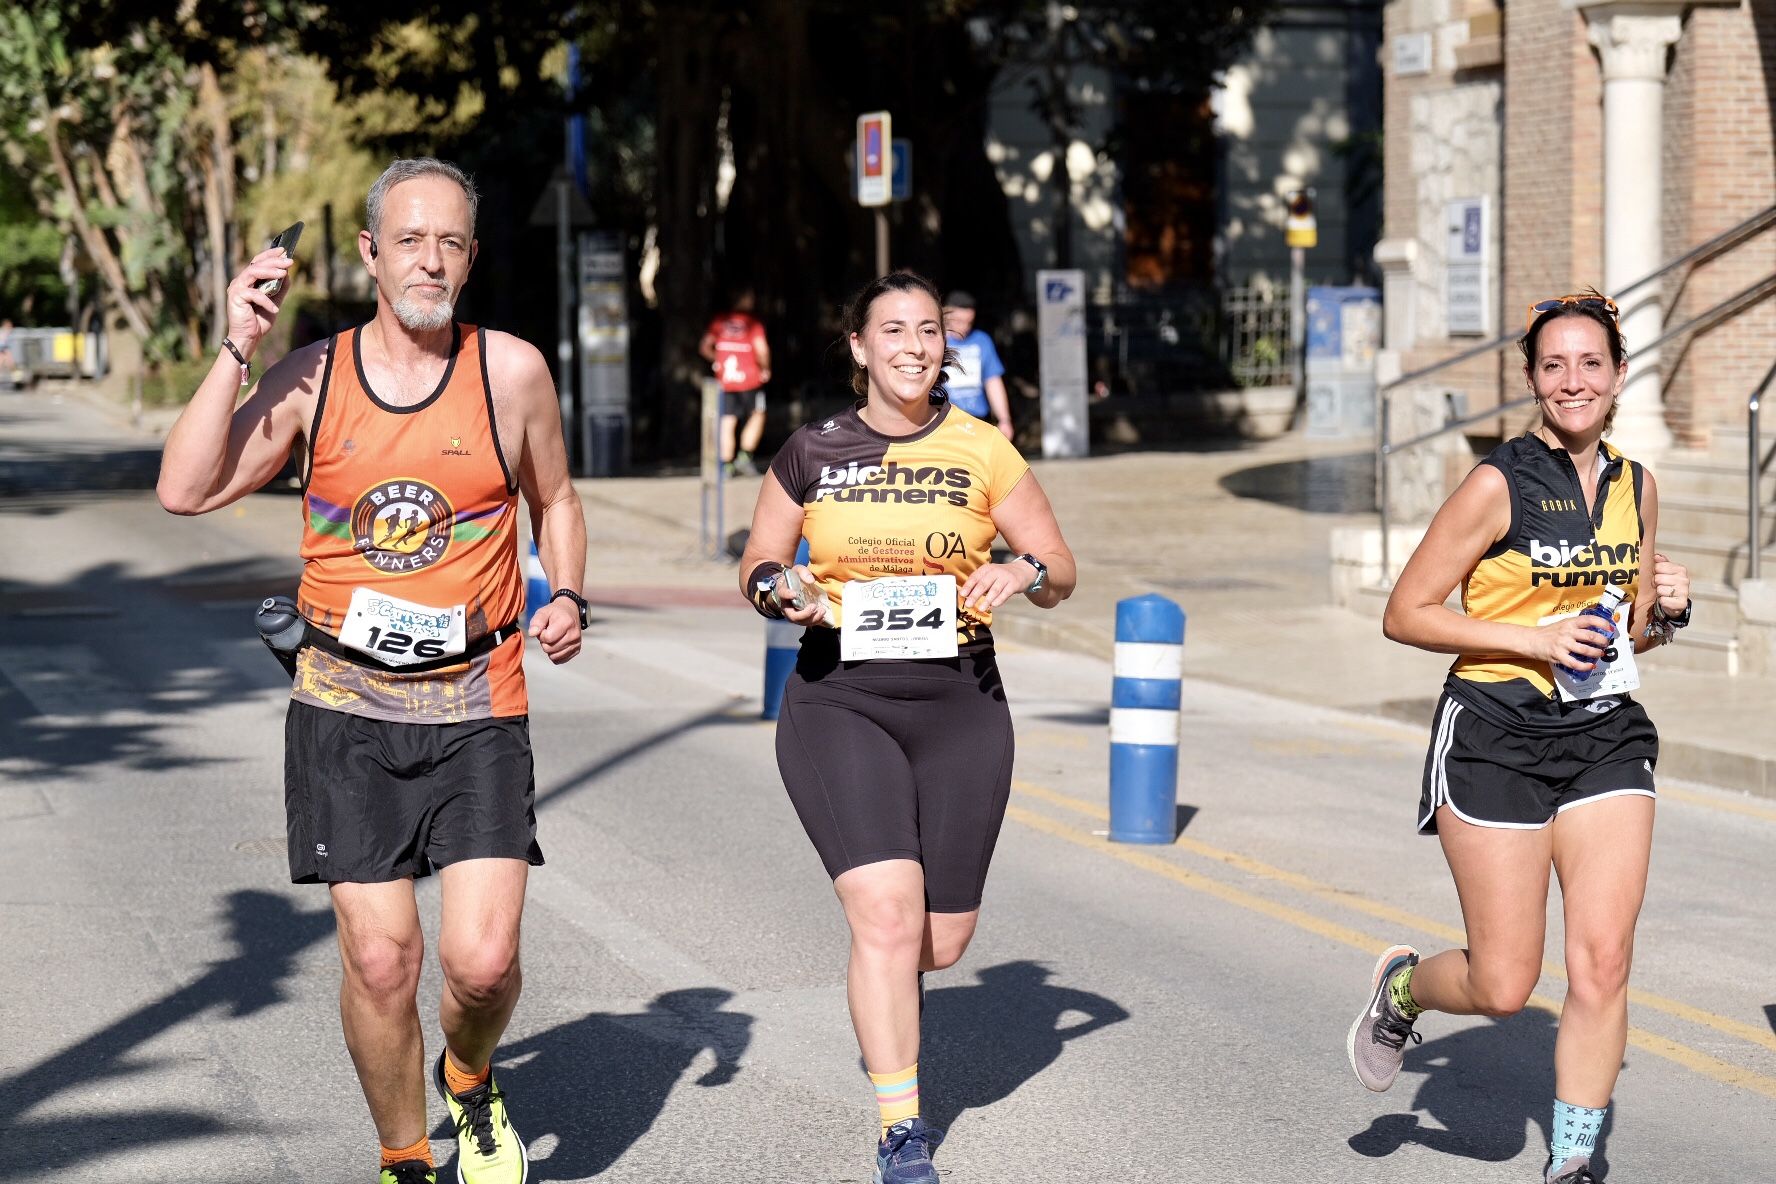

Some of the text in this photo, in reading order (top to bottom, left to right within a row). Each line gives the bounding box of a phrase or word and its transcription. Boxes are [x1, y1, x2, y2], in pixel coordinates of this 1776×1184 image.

[819, 461, 972, 489] bichos
[370, 484, 434, 506] BEER
[816, 488, 969, 507] runners
[1541, 499, 1577, 512] GOBIK
[848, 536, 916, 547] Colegio Oficial
[858, 546, 915, 556] de Gestores
[837, 555, 914, 565] Administrativos
[883, 563, 913, 574] Málaga
[1531, 568, 1640, 588] runner
[855, 607, 945, 632] 354
[365, 626, 448, 659] 126
